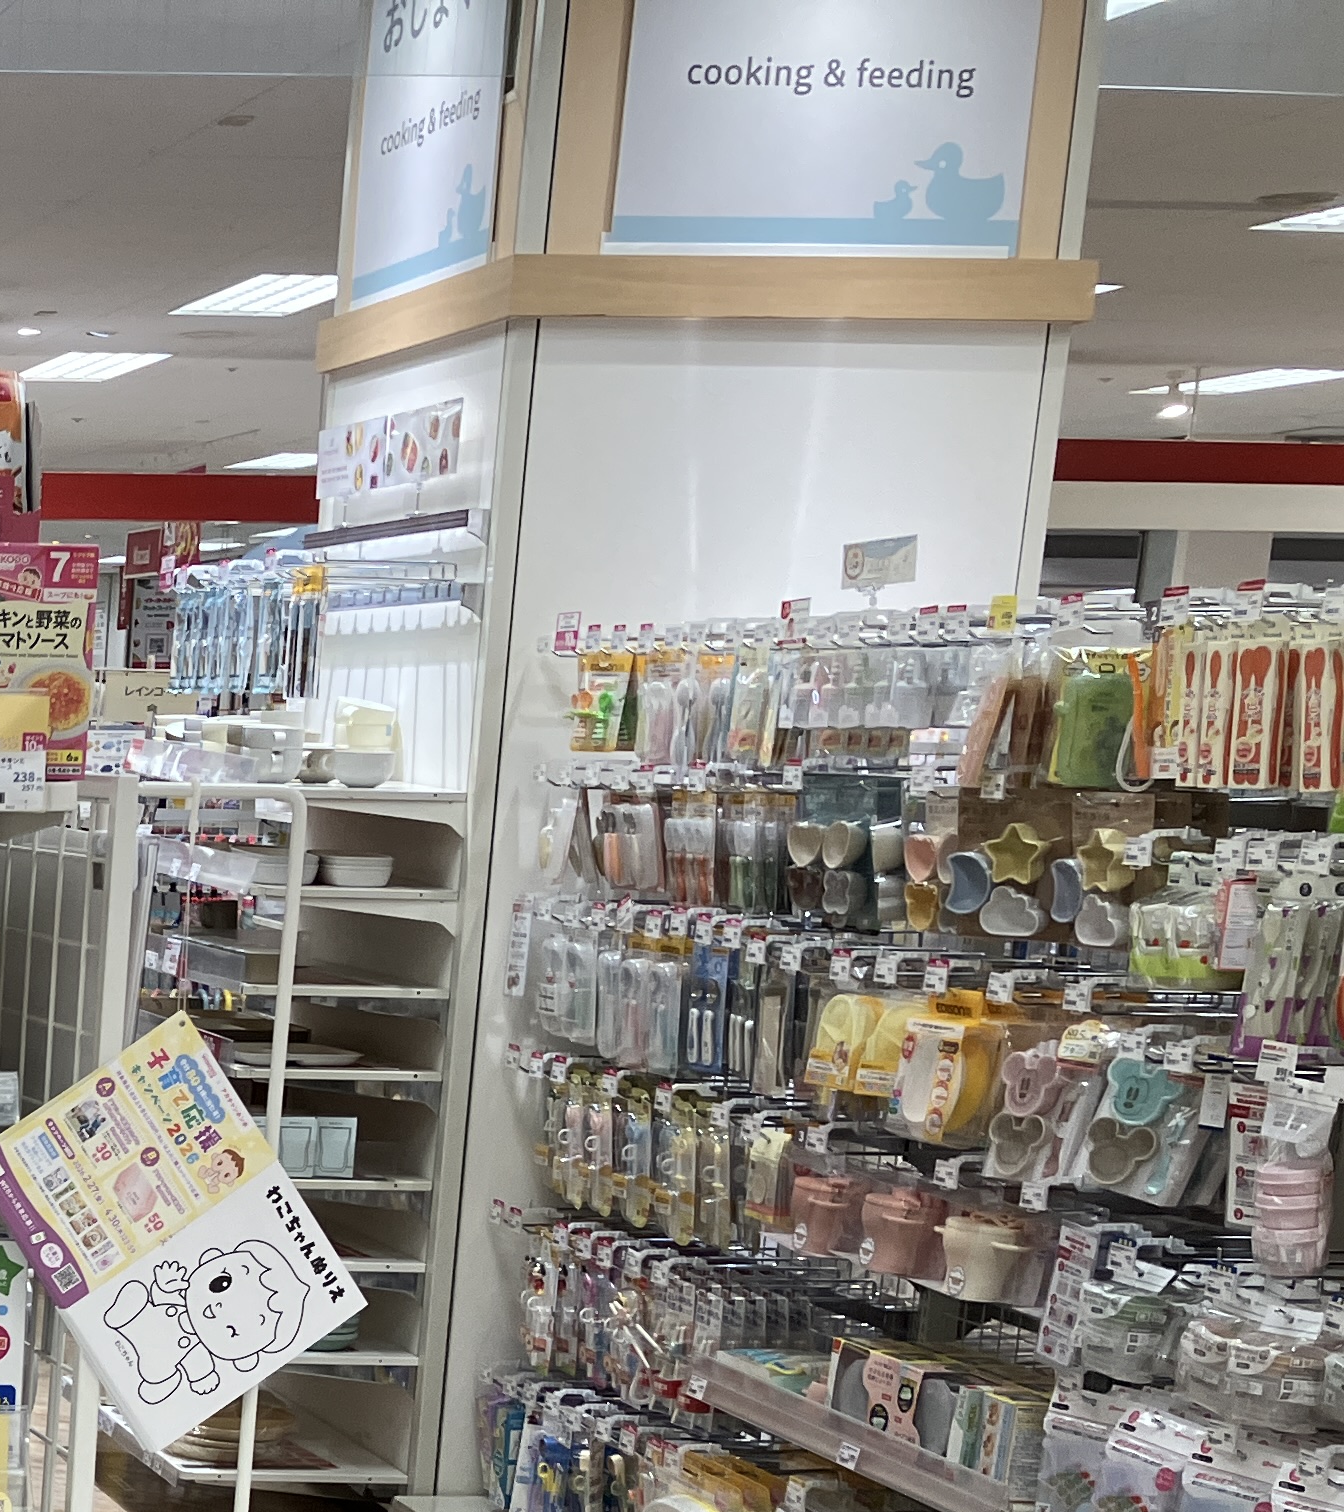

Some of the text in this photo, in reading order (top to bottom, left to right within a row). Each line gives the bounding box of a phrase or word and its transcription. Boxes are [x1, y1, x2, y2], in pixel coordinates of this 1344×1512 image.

[687, 58, 976, 98] cooking & feeding
[380, 89, 480, 156] cooking & feeding
